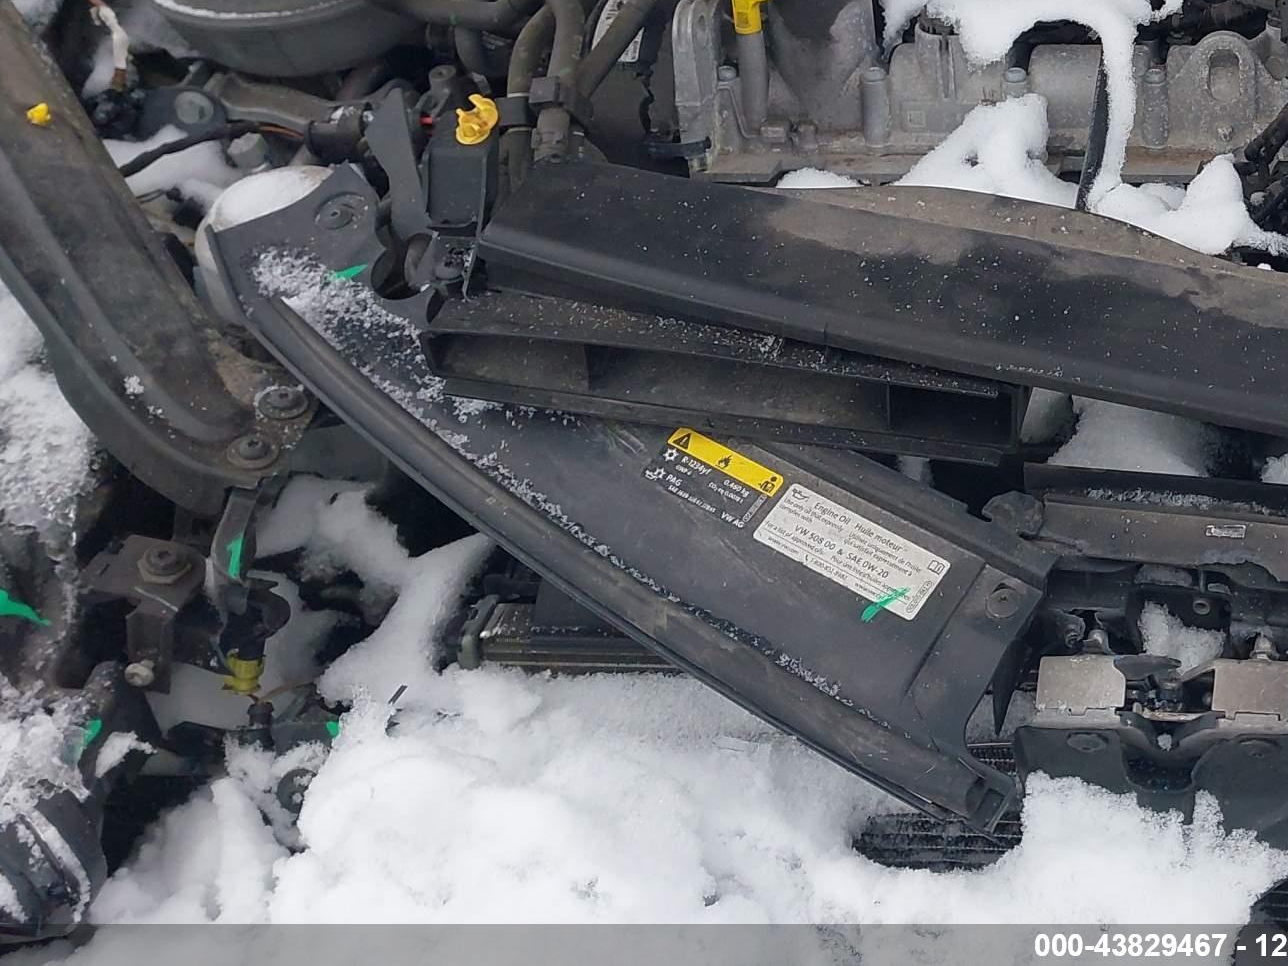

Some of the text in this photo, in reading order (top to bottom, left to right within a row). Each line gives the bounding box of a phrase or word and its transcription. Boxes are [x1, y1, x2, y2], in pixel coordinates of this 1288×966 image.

[678, 455, 712, 477] R-1234yf
[664, 473, 684, 487] PAG
[718, 510, 746, 529] VW AG
[812, 501, 852, 525] Engine Oil
[853, 522, 903, 553] Huile moteur
[793, 523, 890, 579] VW 508 00 & SAE 0W-20
